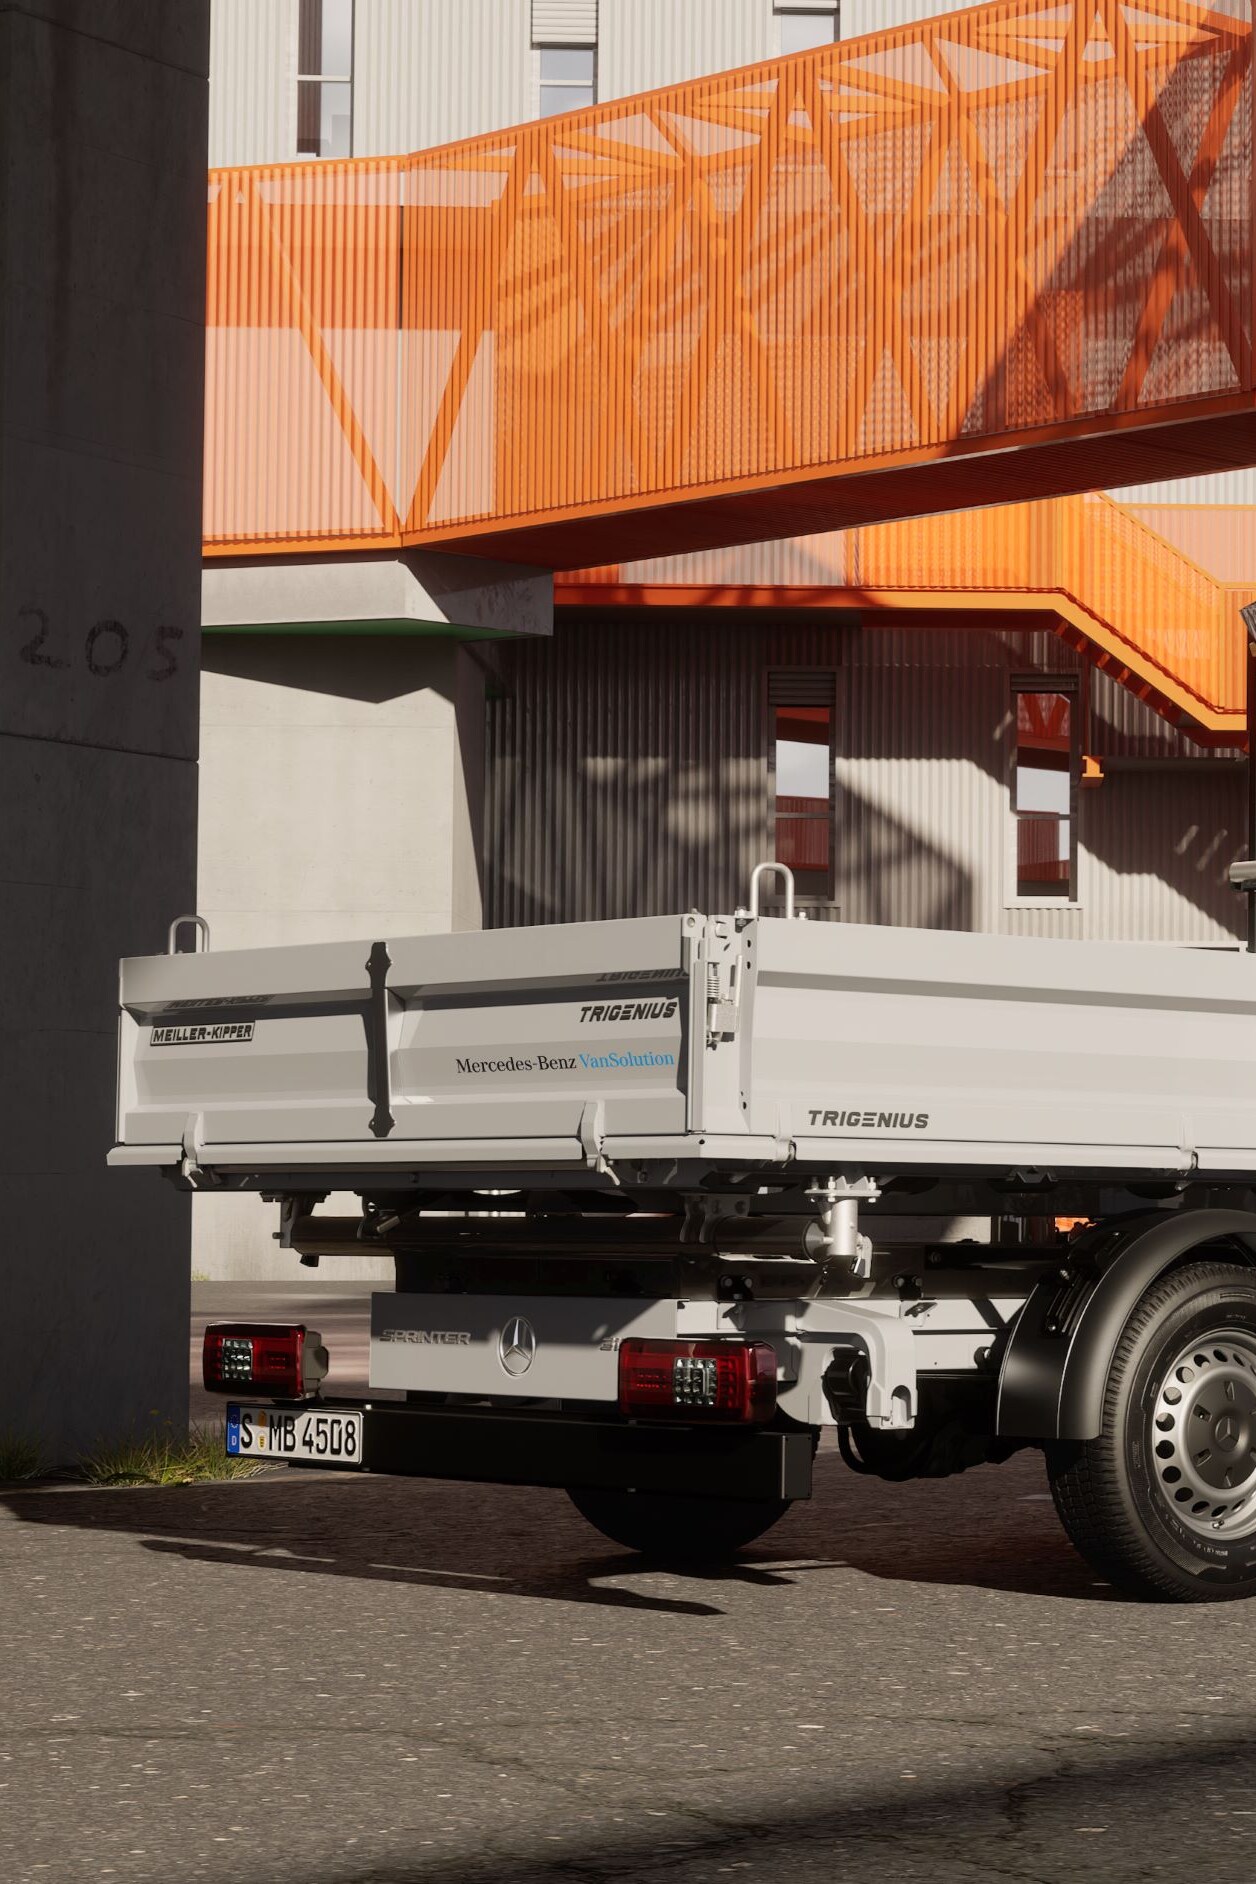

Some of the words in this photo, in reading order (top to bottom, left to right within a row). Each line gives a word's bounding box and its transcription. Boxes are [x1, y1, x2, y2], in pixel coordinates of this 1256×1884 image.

[579, 1001, 678, 1023] TRIGENIUS
[153, 1024, 252, 1043] MEILLER-KIPPER
[455, 1055, 577, 1073] Mercedes-Benz
[578, 1051, 675, 1069] VanSolution
[808, 1110, 930, 1128] TRIGENIUS
[379, 1329, 472, 1345] SPRINTER
[269, 1414, 296, 1452] MB
[302, 1416, 357, 1457] 4508
